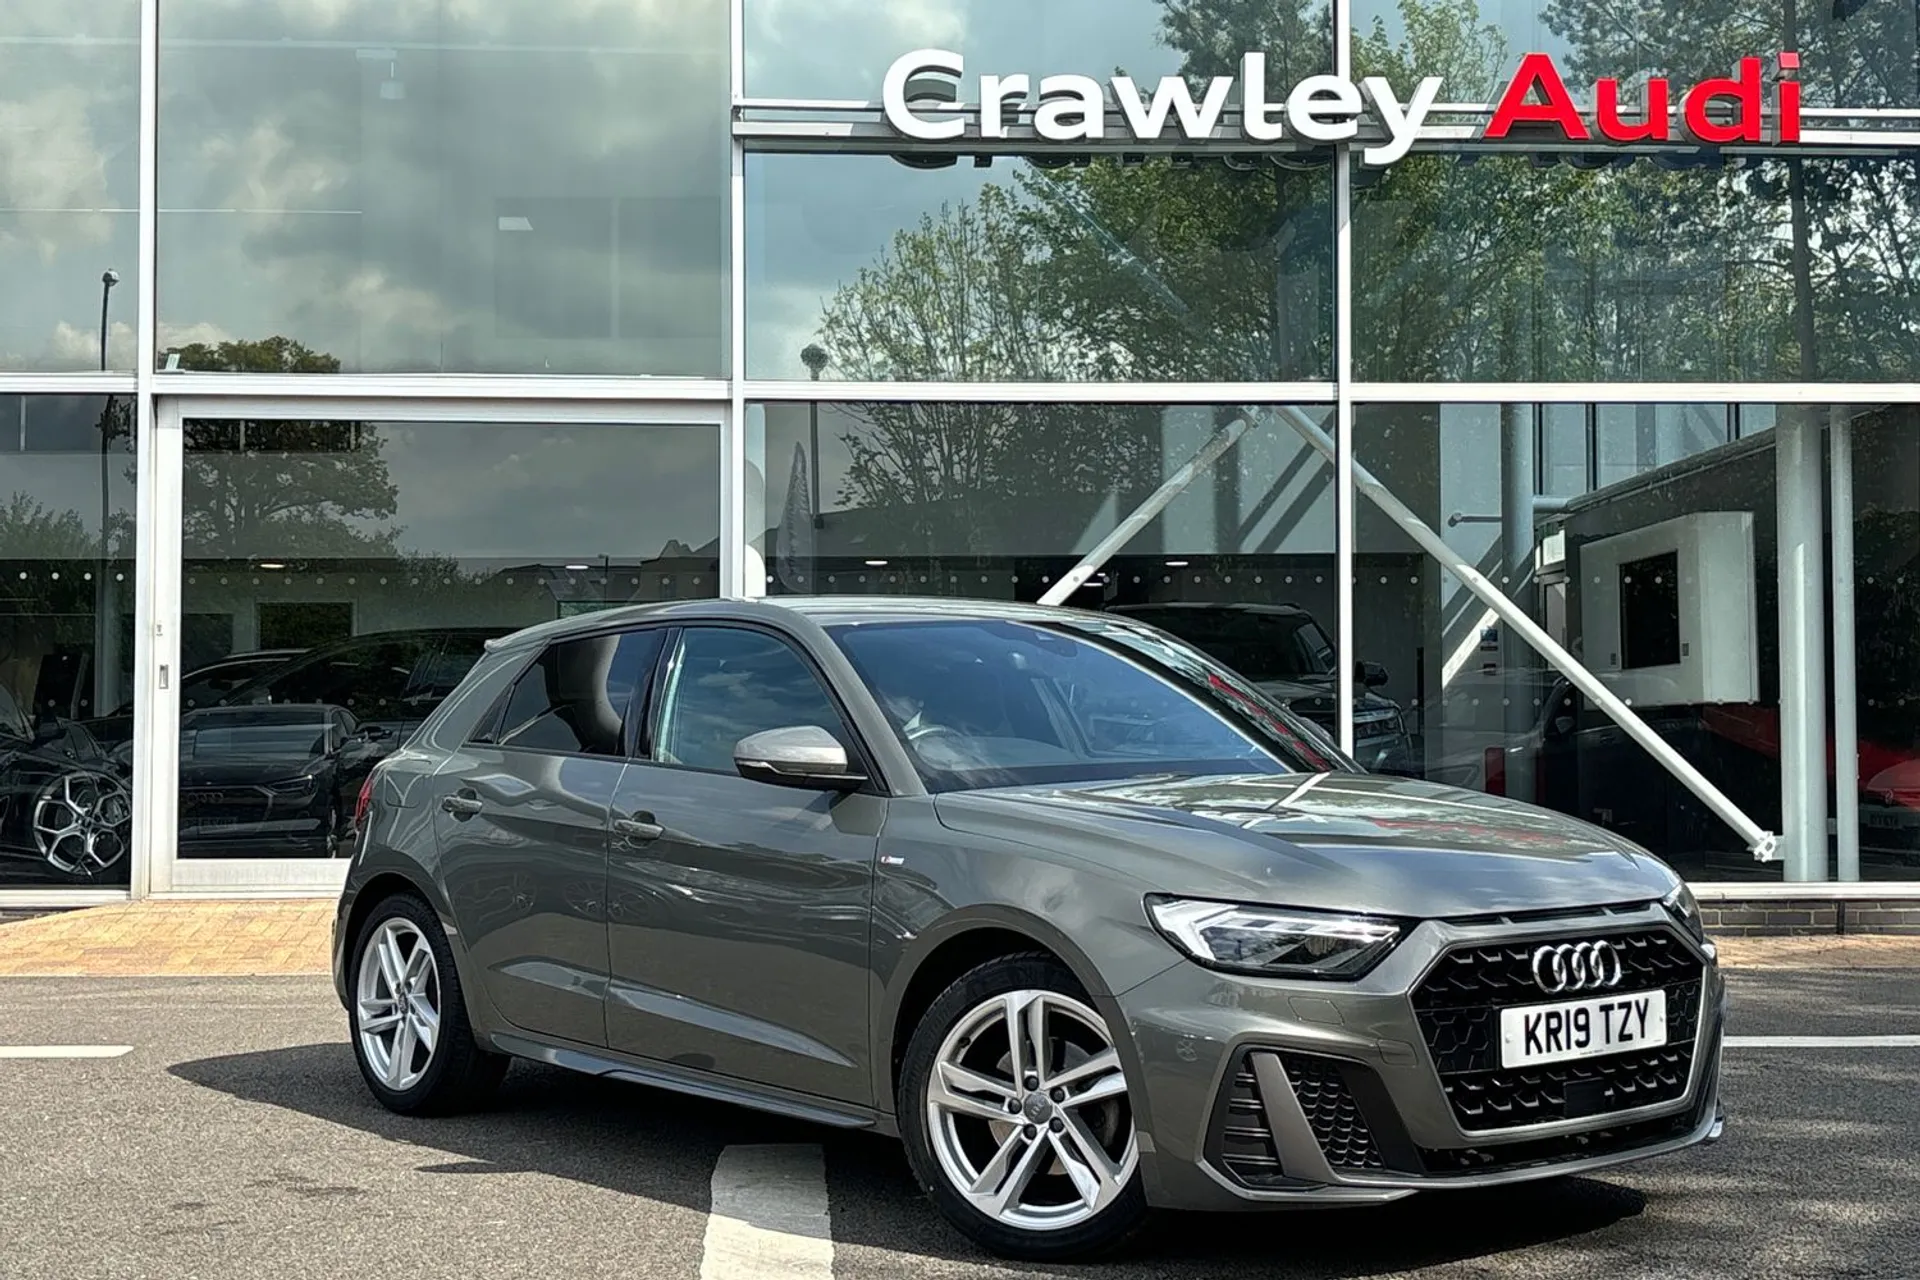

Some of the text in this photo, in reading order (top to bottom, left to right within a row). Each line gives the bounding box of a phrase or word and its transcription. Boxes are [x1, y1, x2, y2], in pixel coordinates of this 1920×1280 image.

[882, 49, 1803, 165] Crawley Audi
[1524, 998, 1650, 1056] KR19 TZY
